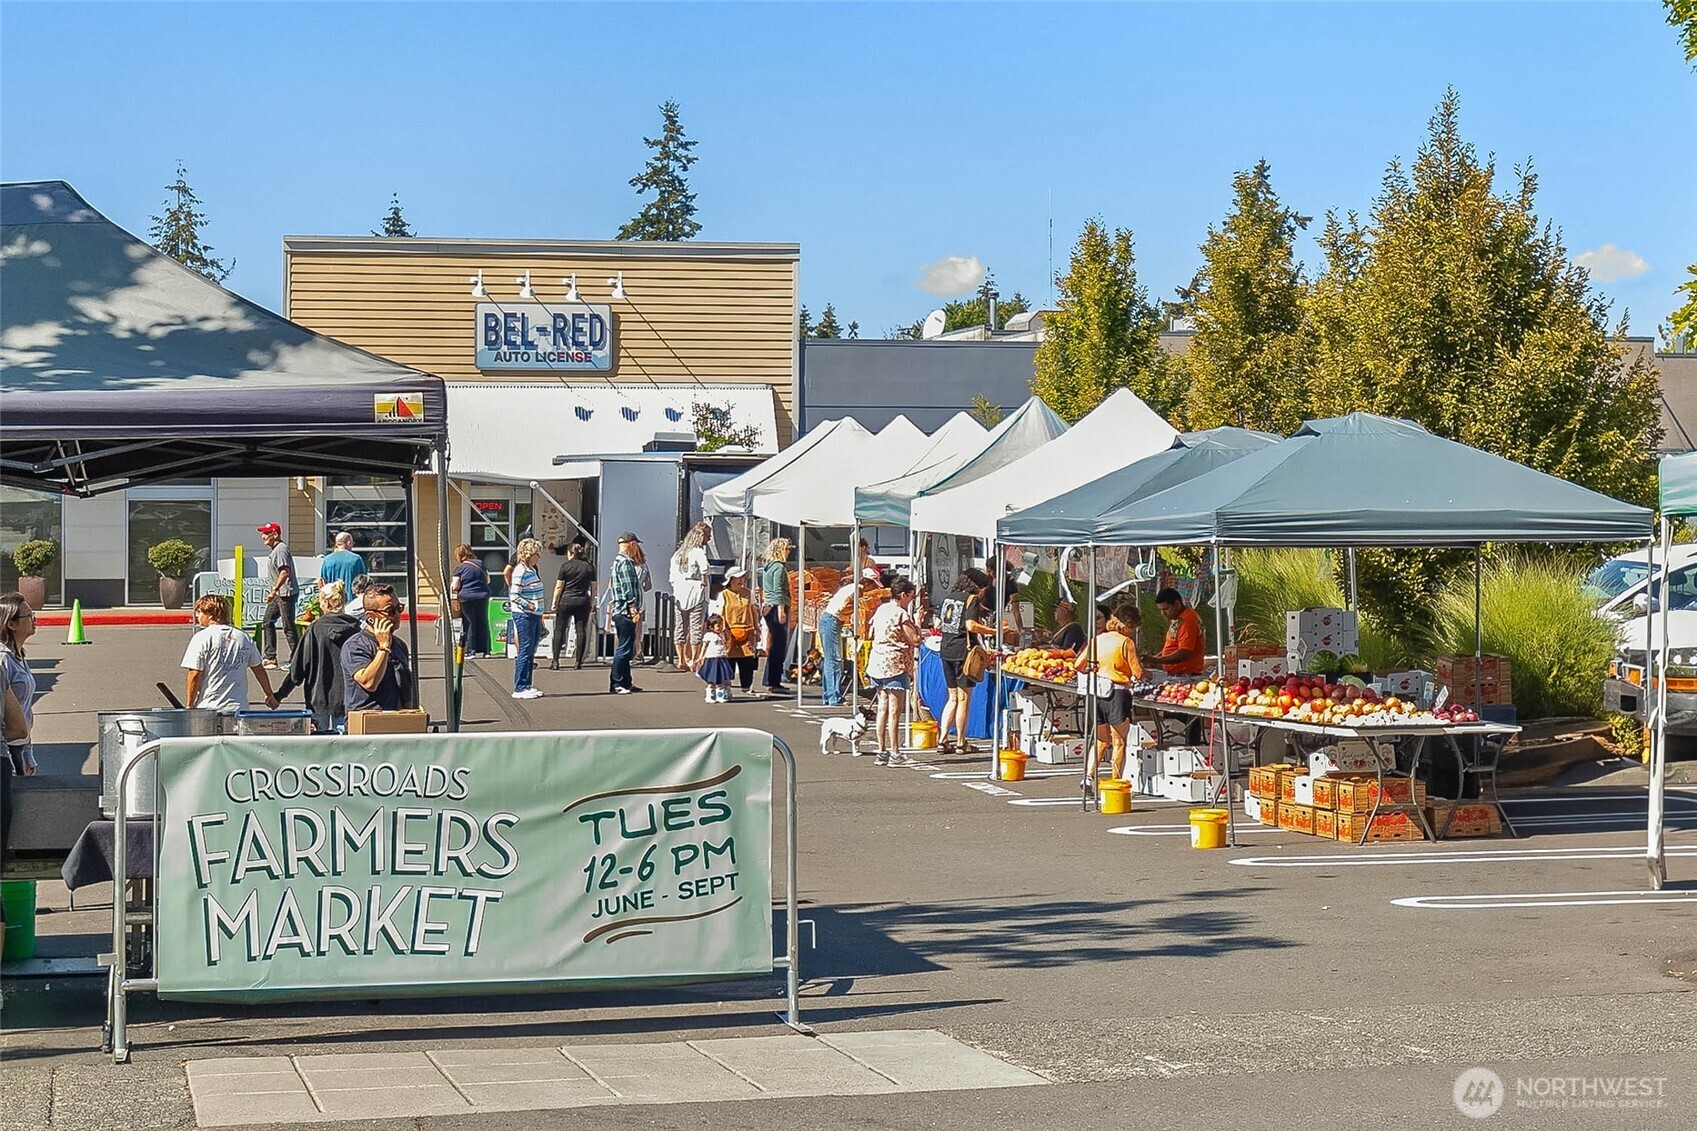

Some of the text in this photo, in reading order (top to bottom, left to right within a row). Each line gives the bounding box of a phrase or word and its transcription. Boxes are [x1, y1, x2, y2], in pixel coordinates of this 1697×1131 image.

[484, 312, 607, 350] BEL-RED
[494, 351, 592, 363] AUTO LICENSE
[474, 502, 503, 510] OPEN
[225, 763, 470, 801] CROSSROADS
[579, 791, 732, 845] TUES
[187, 806, 521, 889] FARMERS
[584, 837, 736, 893] 12-6 PM
[592, 890, 655, 918] JUNE
[678, 873, 739, 900] SEPT
[203, 885, 503, 966] MARKET
